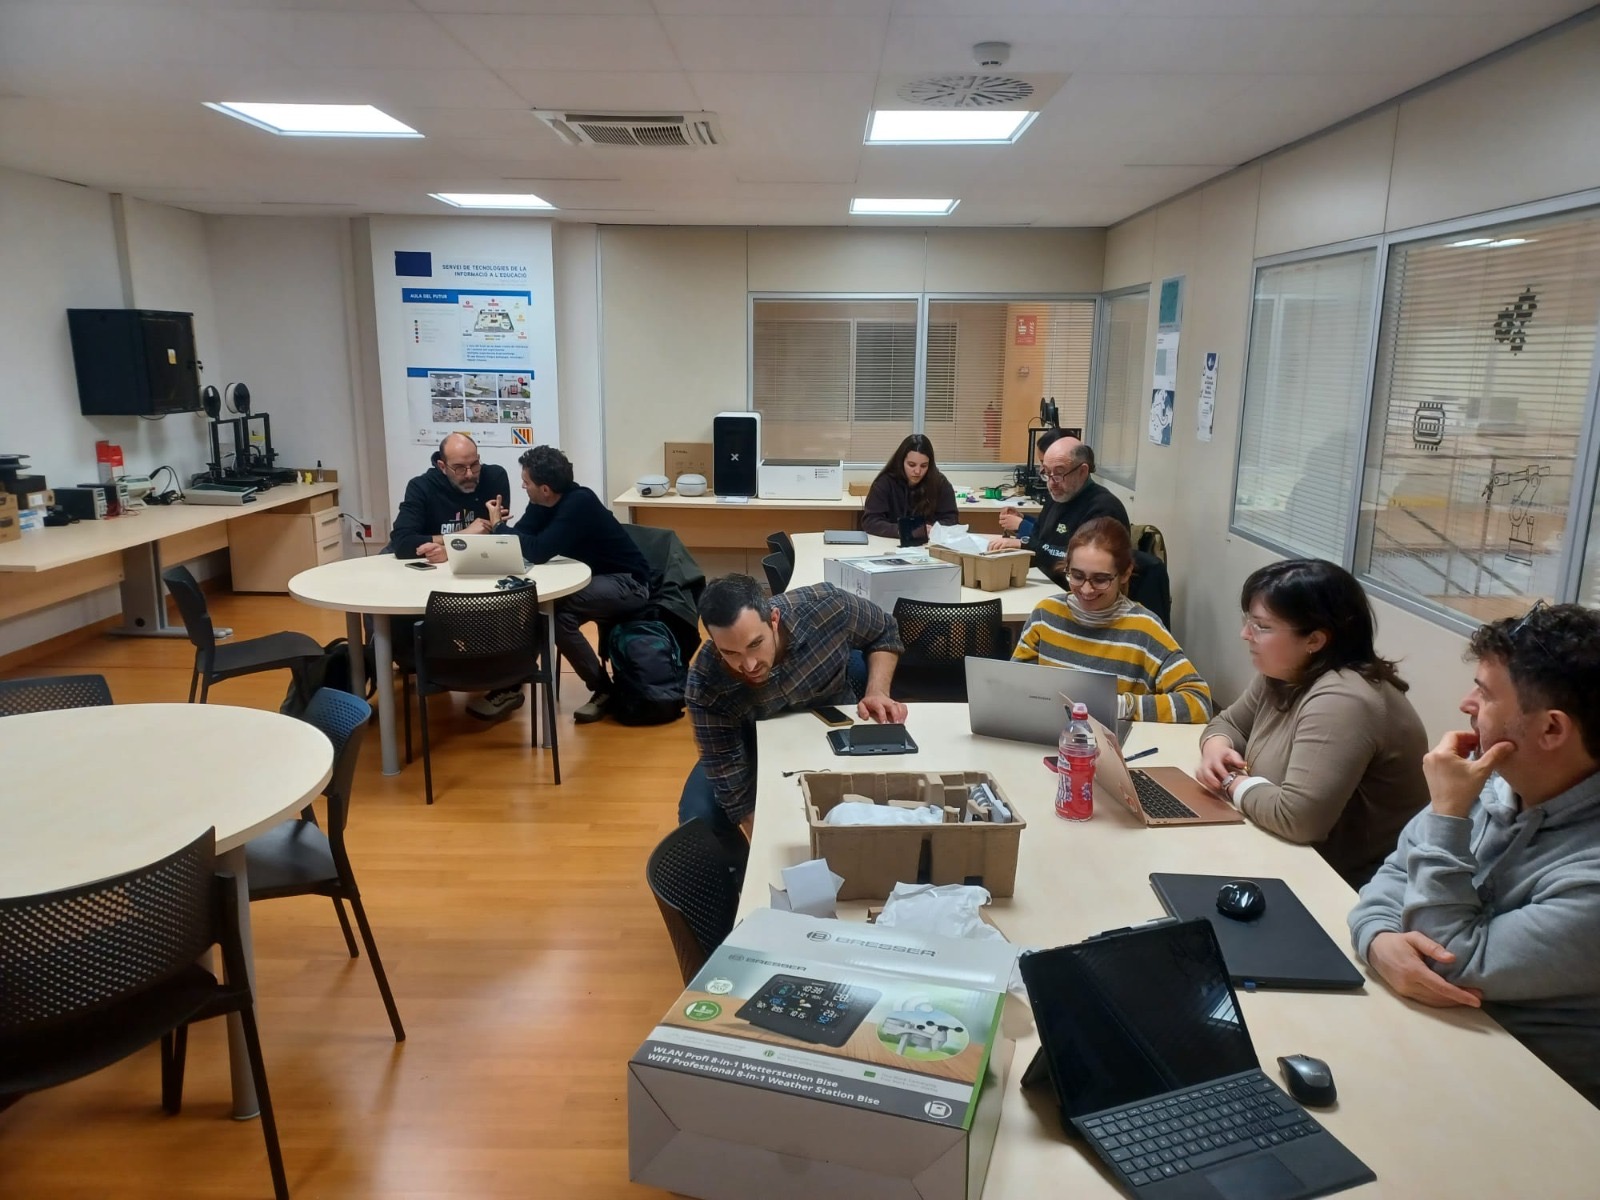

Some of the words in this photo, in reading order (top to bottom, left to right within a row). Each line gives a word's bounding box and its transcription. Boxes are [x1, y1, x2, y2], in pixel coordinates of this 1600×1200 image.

[835, 936, 936, 957] BRESSER
[746, 957, 807, 971] BRESSER
[647, 1053, 672, 1063] WIFI
[673, 1058, 735, 1076] Professional
[736, 1071, 765, 1082] 8-in-1
[768, 1076, 814, 1092] Weather
[815, 1086, 855, 1100] Station
[857, 1095, 880, 1106] Bise
[653, 1046, 683, 1057] WLAN
[685, 1052, 709, 1062] Profi
[711, 1057, 739, 1068] 8-in-1
[741, 1062, 814, 1083] Wetterstation
[816, 1078, 839, 1088] Bise
